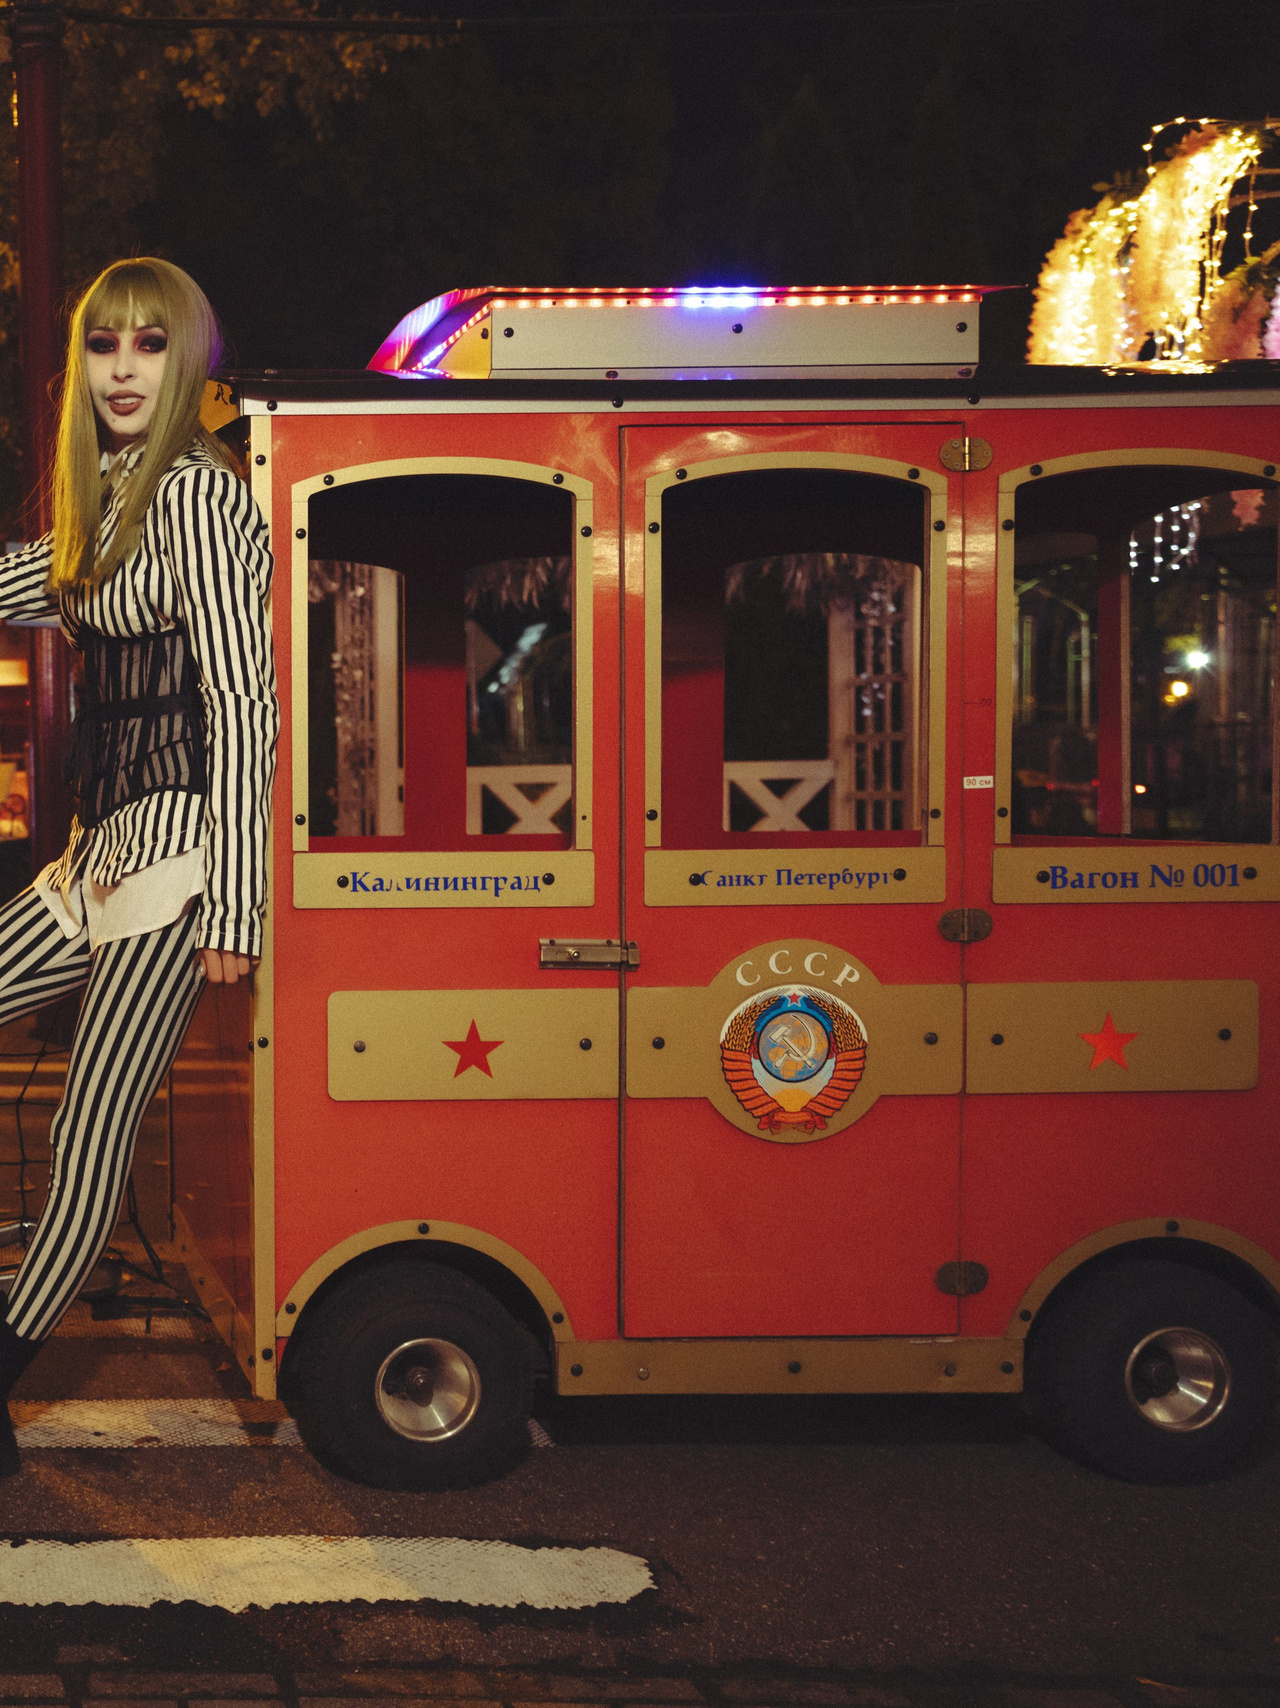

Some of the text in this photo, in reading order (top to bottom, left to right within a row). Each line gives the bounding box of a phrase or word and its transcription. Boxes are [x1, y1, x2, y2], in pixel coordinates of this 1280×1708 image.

[966, 778, 977, 786] 90
[700, 869, 768, 888] Санкт
[1049, 862, 1241, 890] Вагон № 001
[735, 949, 861, 988] СССР
